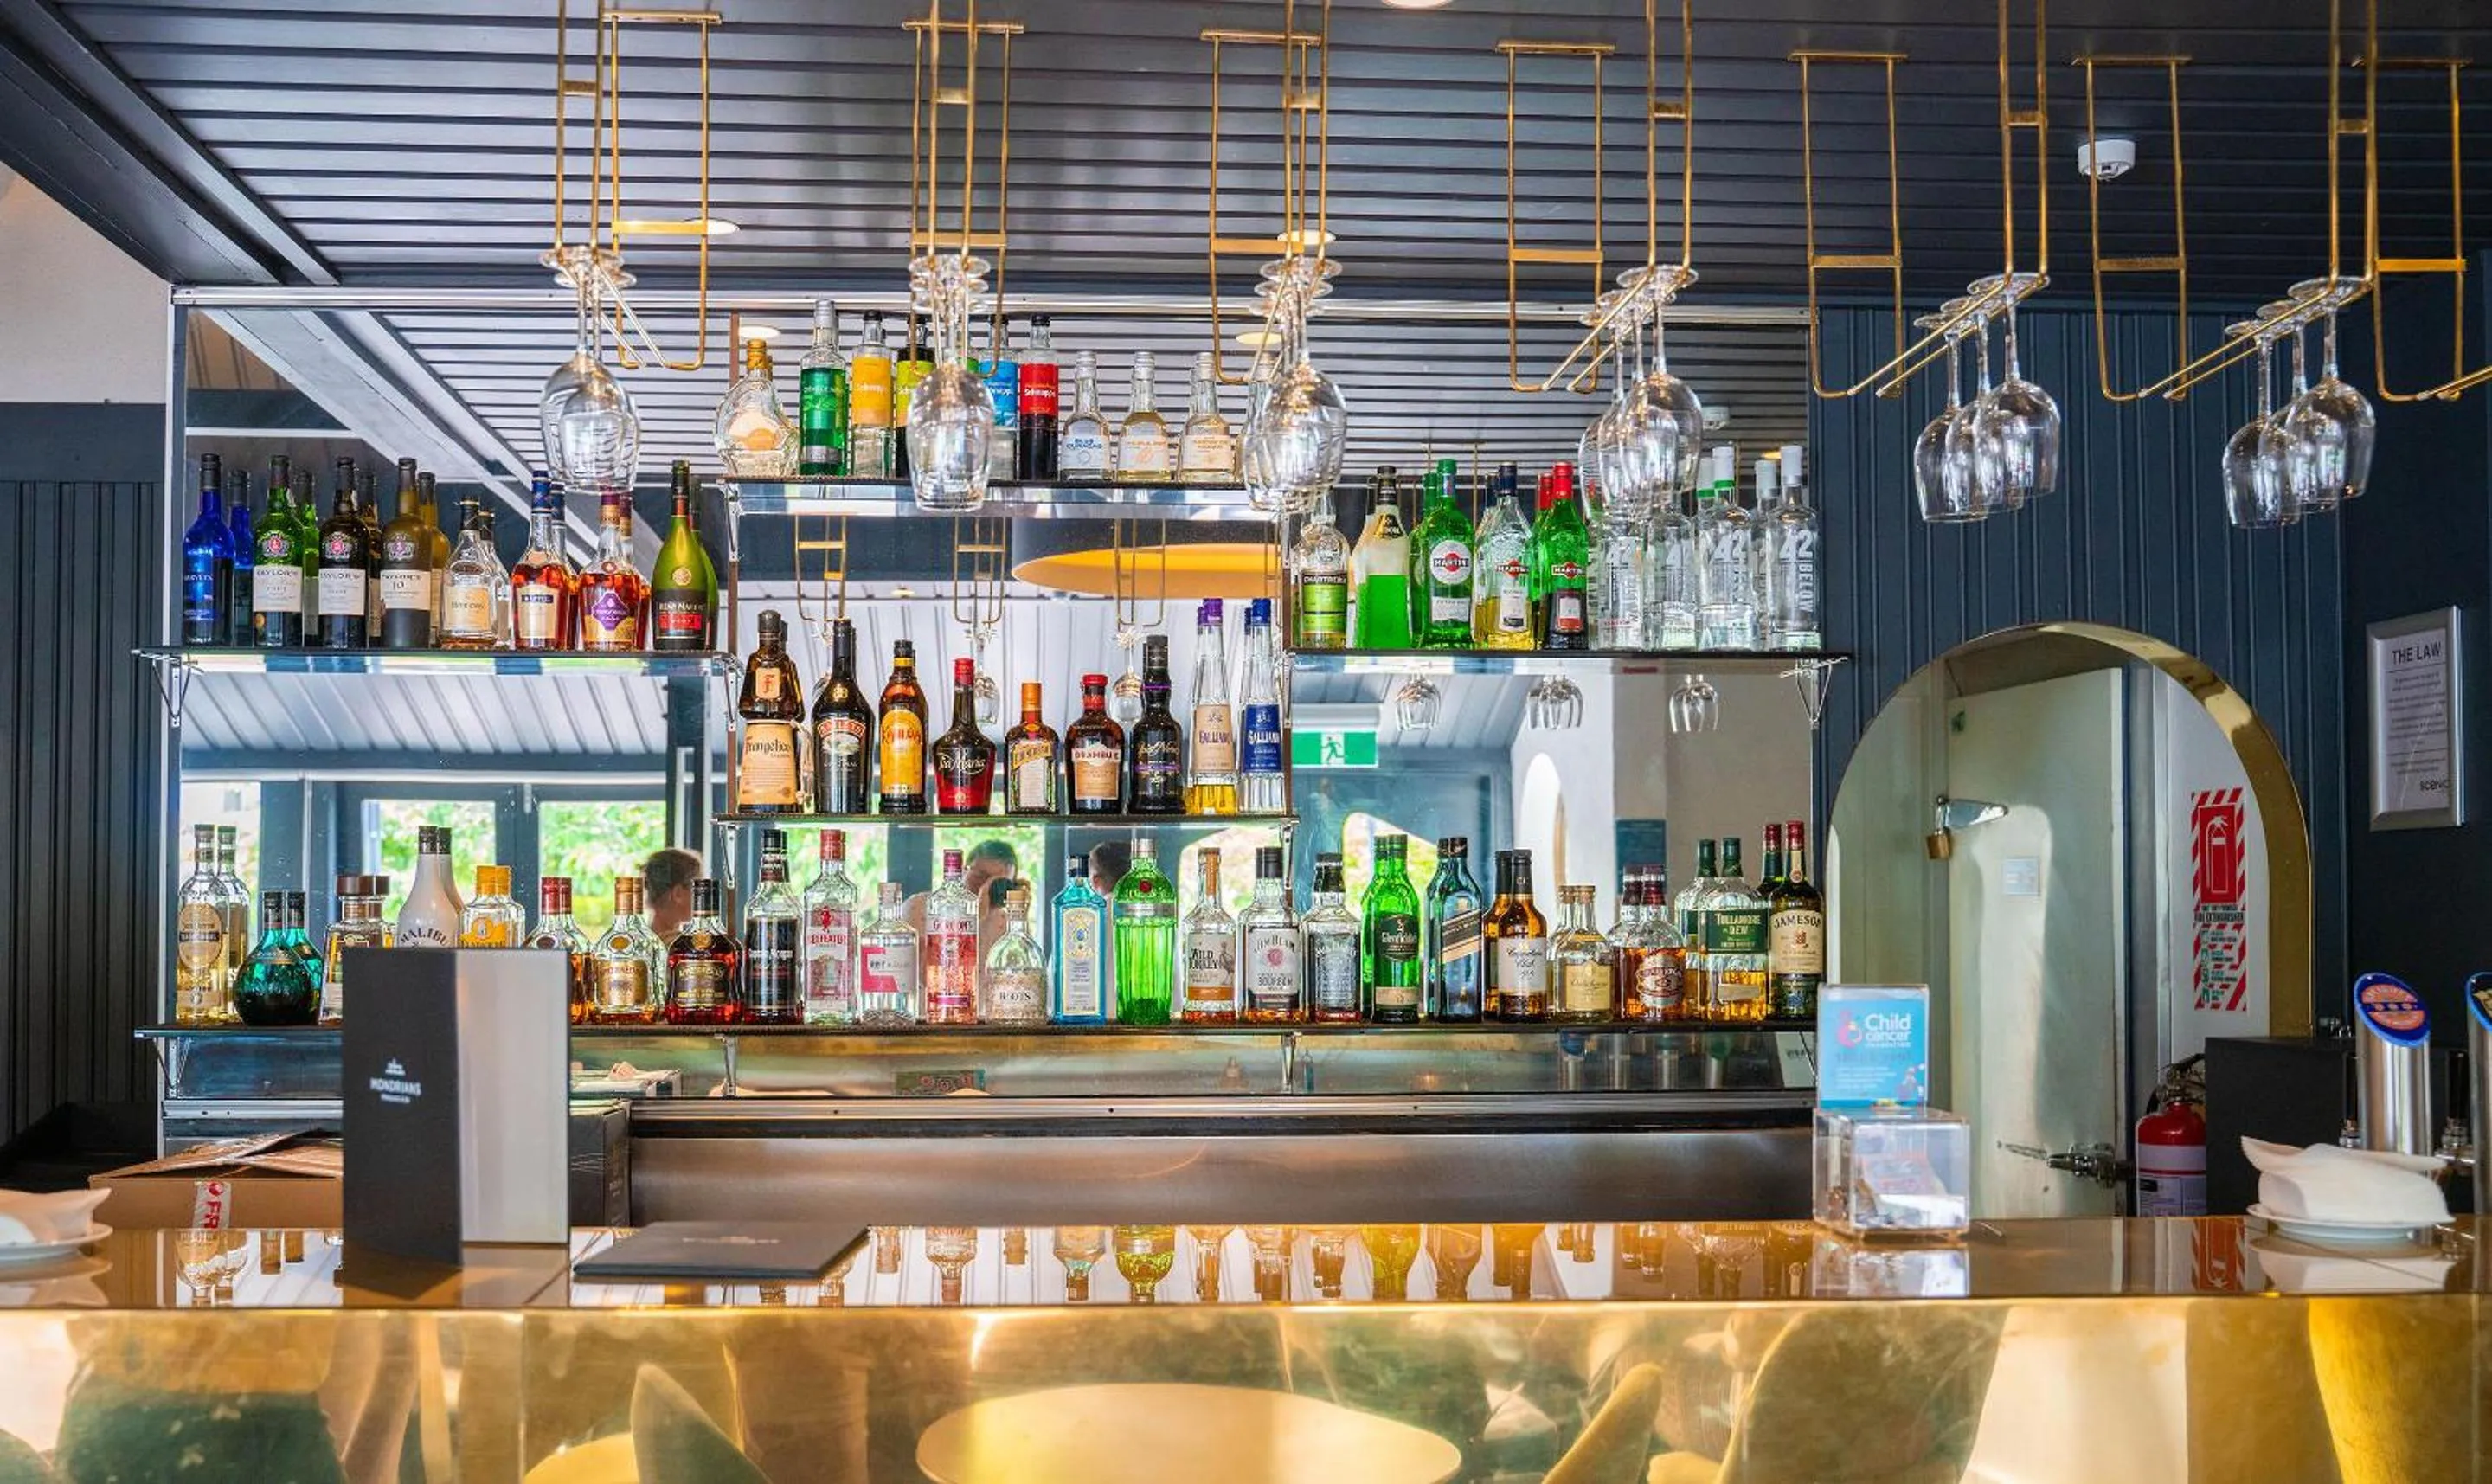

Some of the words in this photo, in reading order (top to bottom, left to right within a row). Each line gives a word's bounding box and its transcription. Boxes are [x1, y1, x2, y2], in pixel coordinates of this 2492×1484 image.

[1779, 528, 1814, 561] 42
[1432, 559, 1470, 568] MARTINI
[1799, 562, 1814, 613] BELOW
[2392, 646, 2414, 665] THE
[2417, 641, 2442, 660] LAW
[400, 928, 450, 946] MALIBU
[1191, 949, 1214, 960] WILD
[1865, 1012, 1911, 1031] Child
[1865, 1031, 1911, 1042] cancer
